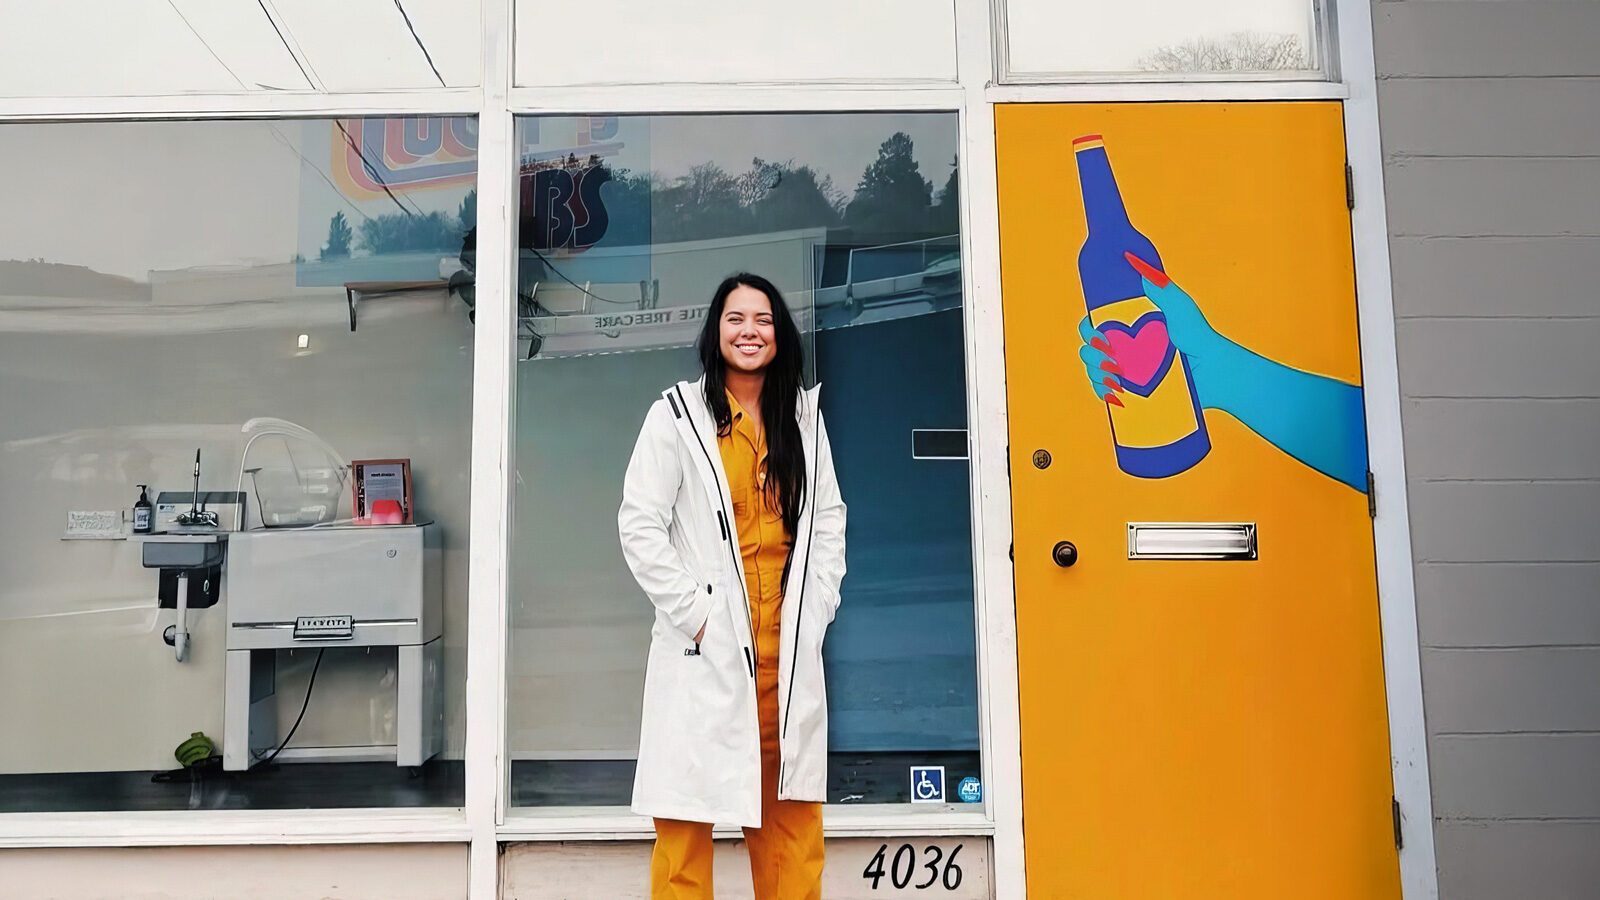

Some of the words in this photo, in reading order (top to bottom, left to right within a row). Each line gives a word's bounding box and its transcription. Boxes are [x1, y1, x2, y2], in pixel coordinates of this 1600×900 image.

[533, 160, 609, 249] BS
[961, 782, 980, 794] ADT
[863, 844, 963, 890] 4036
